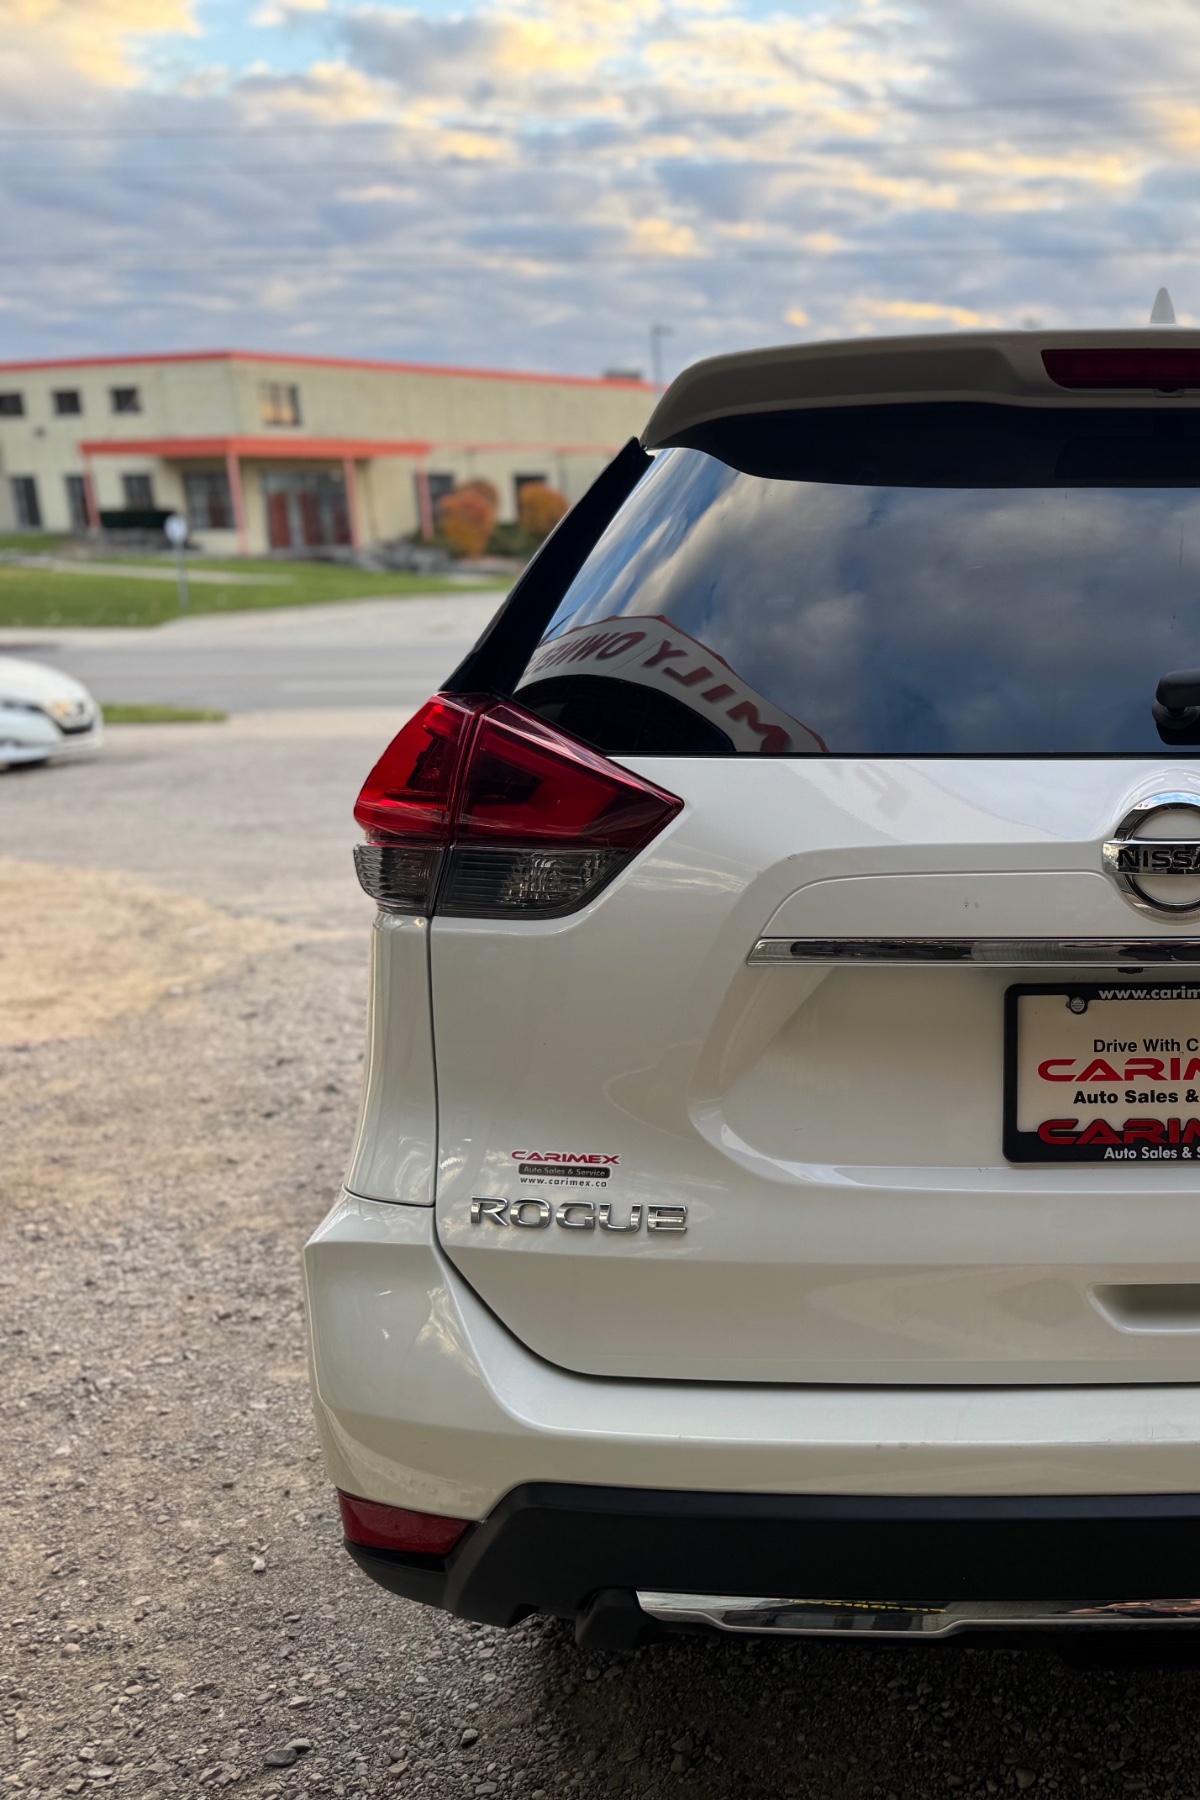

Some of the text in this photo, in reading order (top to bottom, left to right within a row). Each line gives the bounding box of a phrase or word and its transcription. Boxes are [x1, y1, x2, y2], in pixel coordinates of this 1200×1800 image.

[1093, 1038, 1137, 1053] Drive
[1142, 1038, 1180, 1052] With
[1073, 1090, 1118, 1104] Auto
[1124, 1089, 1179, 1104] Sales
[1185, 1089, 1200, 1103] &
[511, 1150, 621, 1165] CARIMEX
[1104, 1147, 1137, 1160] Auto
[1141, 1147, 1178, 1160] Sales
[1182, 1147, 1192, 1158] &
[523, 1166, 542, 1174] Auto
[544, 1166, 566, 1175] Sales
[576, 1168, 606, 1177] Service
[520, 1176, 608, 1188] www.carimex.ca
[470, 1195, 688, 1235] ROGUE
